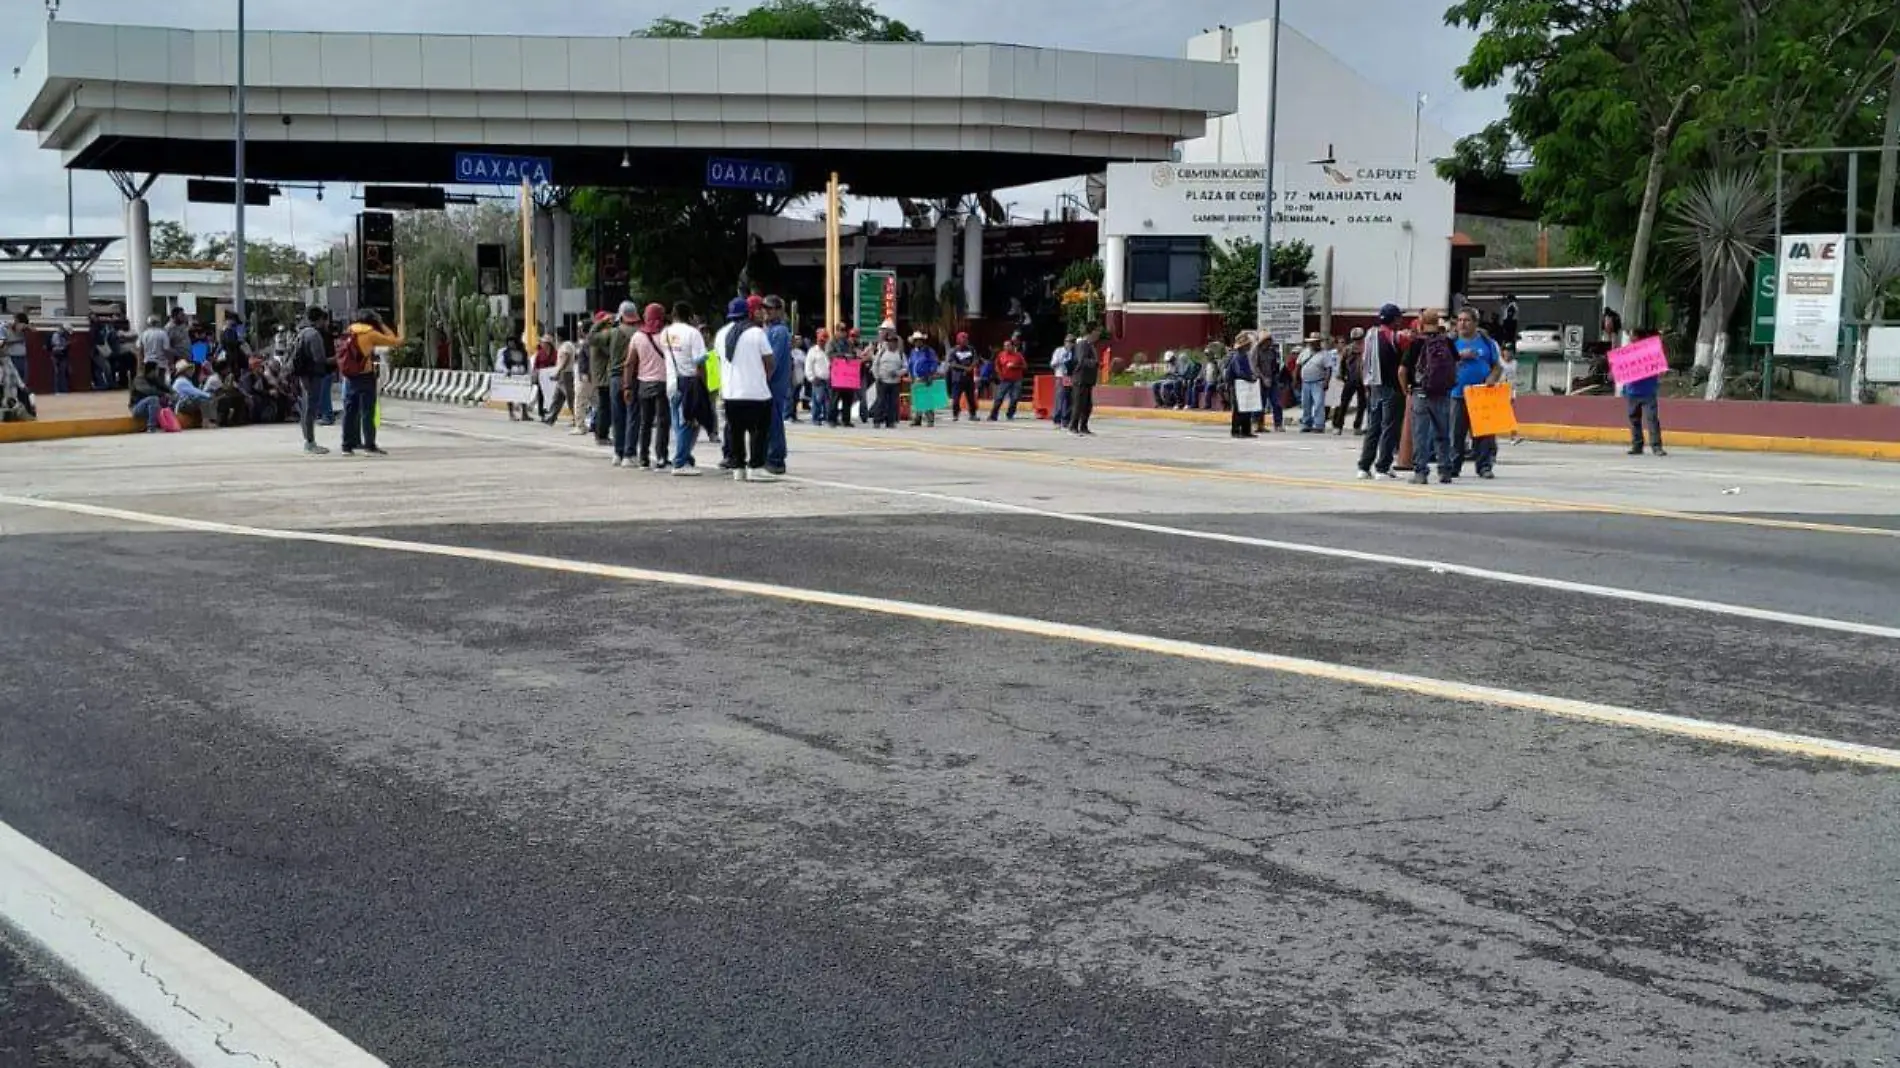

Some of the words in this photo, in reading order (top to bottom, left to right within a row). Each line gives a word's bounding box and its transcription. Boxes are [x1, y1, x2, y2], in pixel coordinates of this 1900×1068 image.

[461, 158, 546, 180] OAXACA
[711, 163, 787, 184] OAXACA
[1356, 168, 1417, 180] CAPUFE
[1185, 191, 1222, 201] PLAZA
[1284, 191, 1298, 201] 77
[1308, 191, 1403, 201] MIAHUATLAN
[1788, 242, 1837, 260] IAVE
